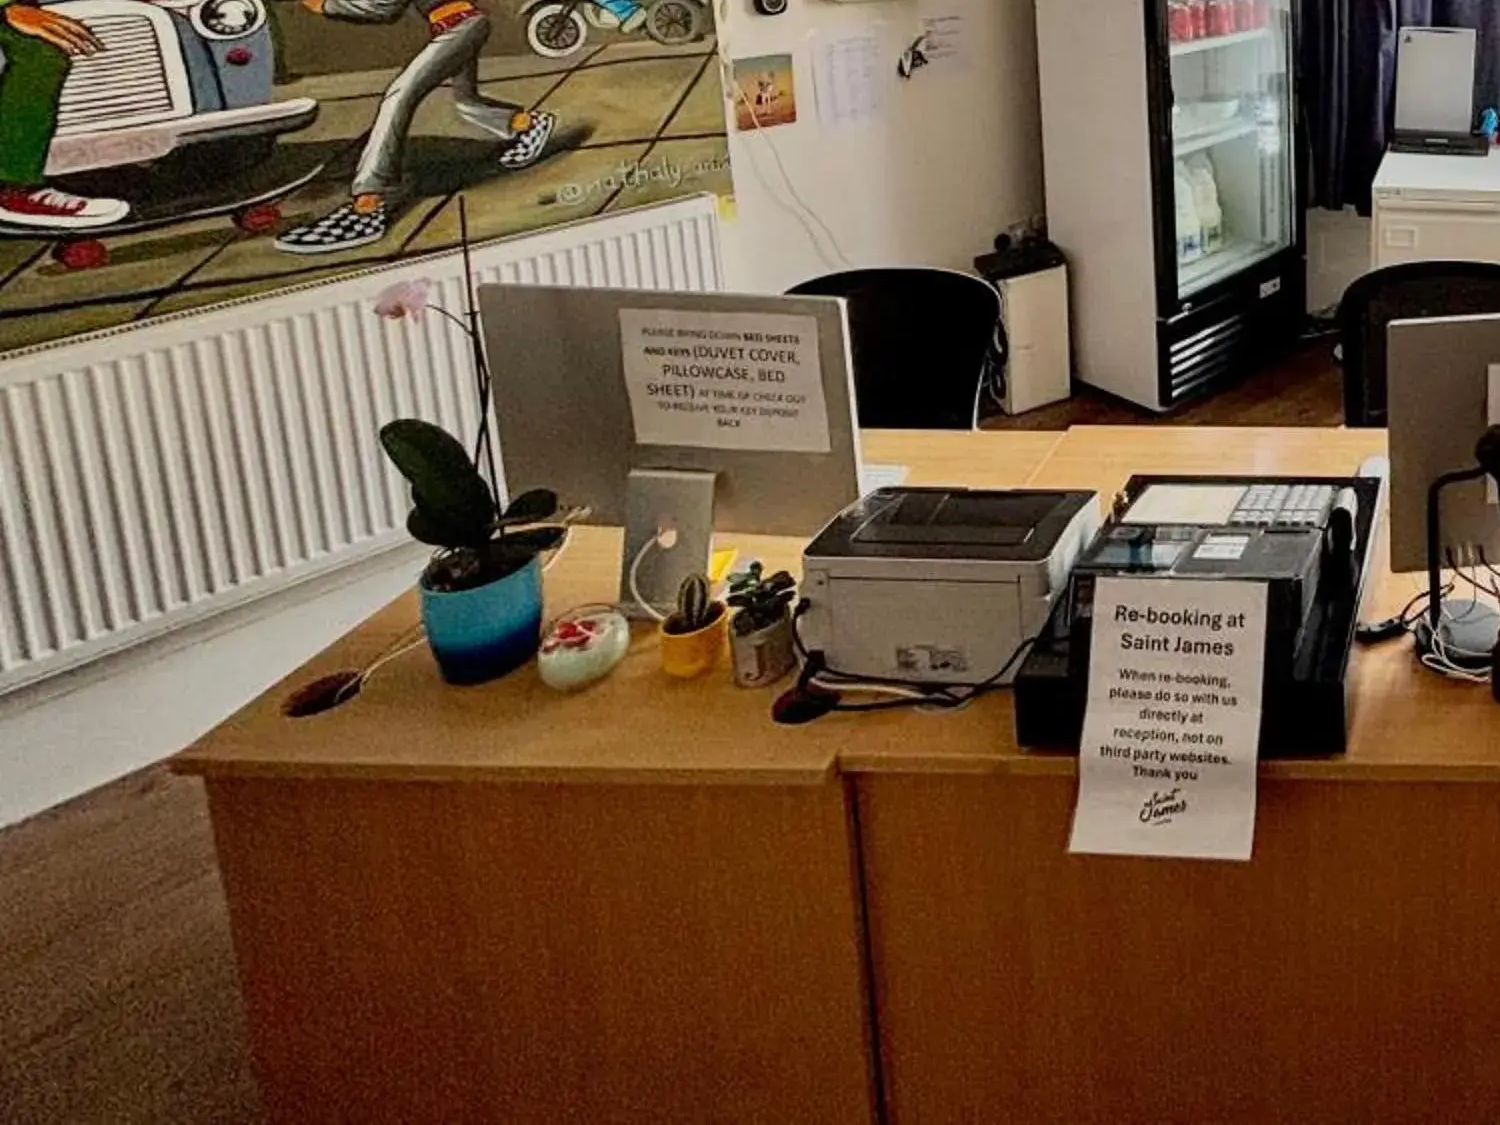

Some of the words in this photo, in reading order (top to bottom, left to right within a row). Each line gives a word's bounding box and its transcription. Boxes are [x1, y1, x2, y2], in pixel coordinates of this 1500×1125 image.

[765, 334, 800, 344] SHEETS
[643, 347, 666, 357] AND
[693, 346, 746, 360] (DUVET
[749, 349, 801, 365] COVER,
[663, 364, 755, 382] PILLOWCASE,
[757, 368, 785, 383] BED
[647, 383, 695, 399] SHEET)
[717, 417, 741, 428] BACK
[1115, 605, 1222, 631] Re-booking
[1227, 614, 1246, 629] at
[1120, 633, 1170, 653] Saint
[1174, 637, 1234, 657] James
[1119, 668, 1156, 681] When
[1158, 671, 1231, 689] re-booking,
[1109, 687, 1152, 701] please
[1154, 691, 1171, 703] do
[1174, 693, 1189, 703] so
[1192, 691, 1219, 705] with
[1222, 696, 1238, 707] us
[1139, 709, 1188, 724] directly
[1189, 712, 1204, 723] at
[1113, 727, 1178, 744] reception,
[1182, 731, 1203, 744] not
[1206, 734, 1223, 745] on
[1100, 746, 1130, 759] third
[1133, 750, 1166, 764] party
[1169, 751, 1232, 765] websites.
[1132, 765, 1172, 780] Thank
[1175, 769, 1198, 781] you
[1144, 788, 1182, 807] Saint
[1139, 800, 1187, 822] James
